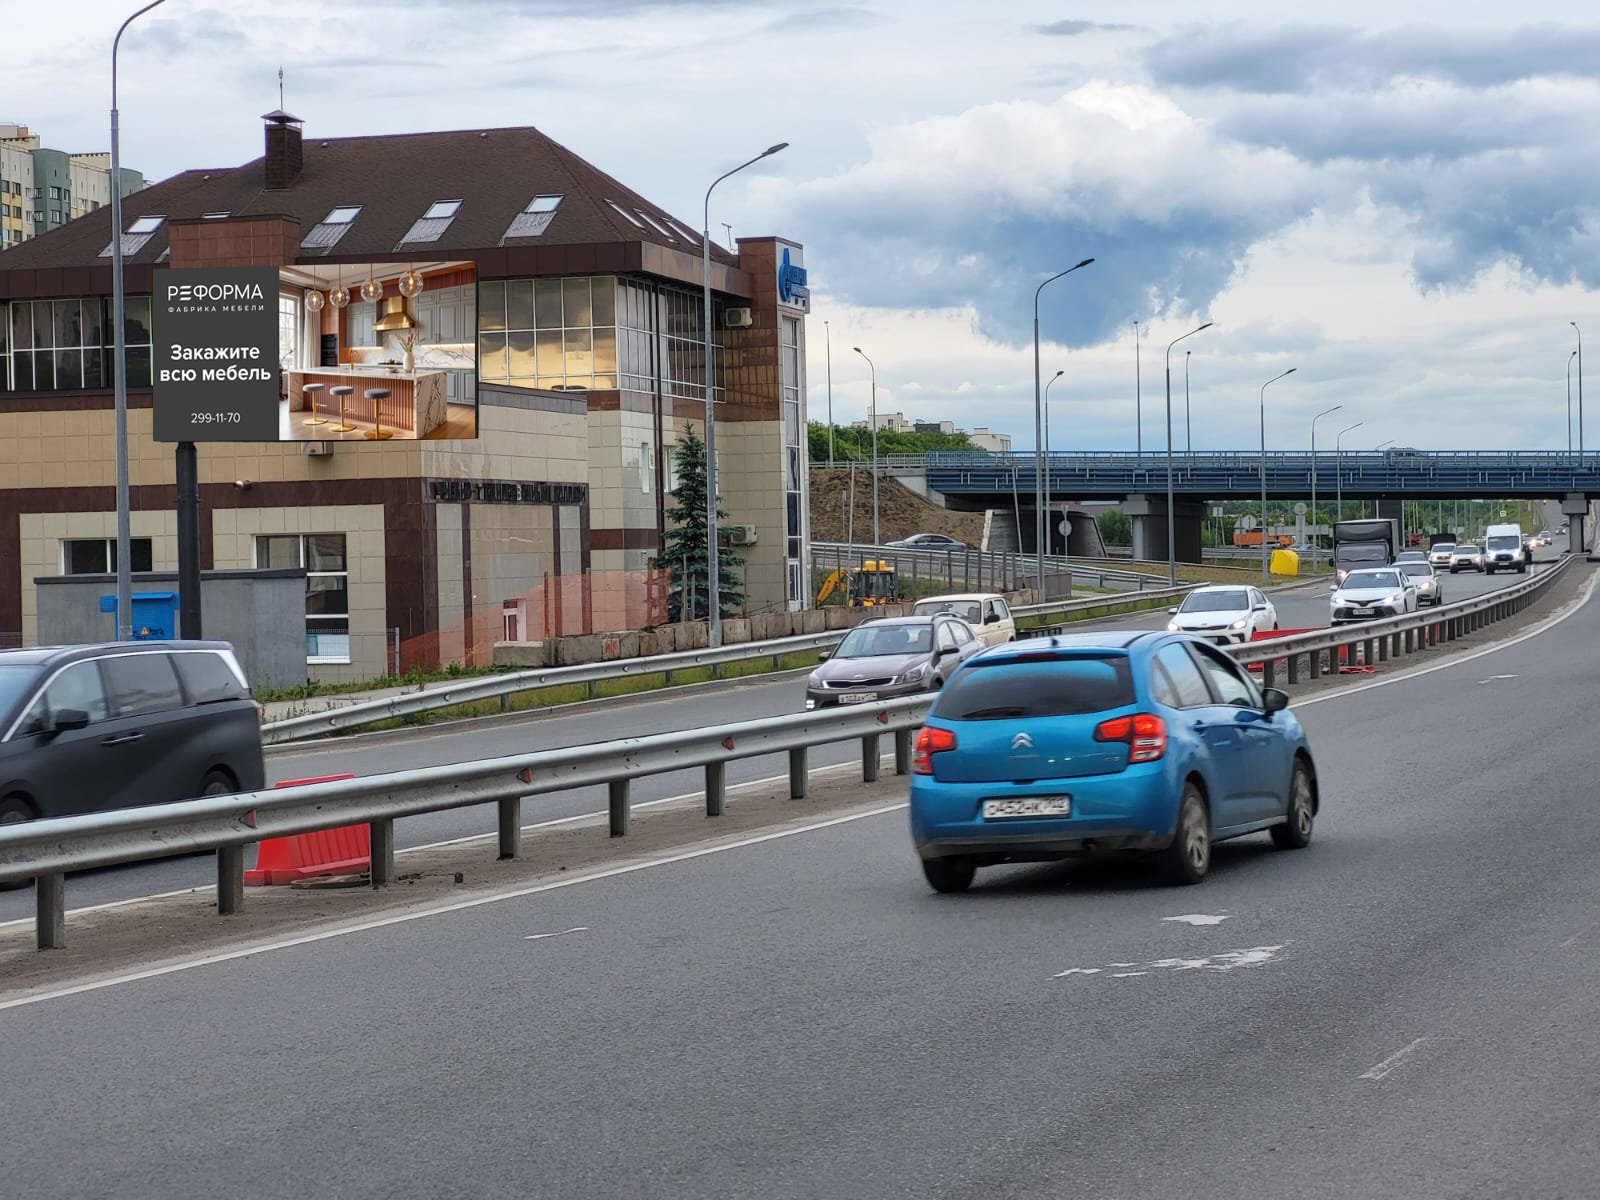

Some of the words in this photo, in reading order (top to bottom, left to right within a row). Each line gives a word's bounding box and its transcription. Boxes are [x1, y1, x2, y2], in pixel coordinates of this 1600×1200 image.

[167, 283, 264, 301] РЕФОРМА
[167, 305, 217, 313] ФАБРИКА
[222, 304, 264, 312] МЕБЕЛИ
[170, 343, 261, 361] Закажите
[160, 369, 197, 382] всю
[201, 364, 272, 381] мебель
[190, 412, 241, 424] 299-11-70
